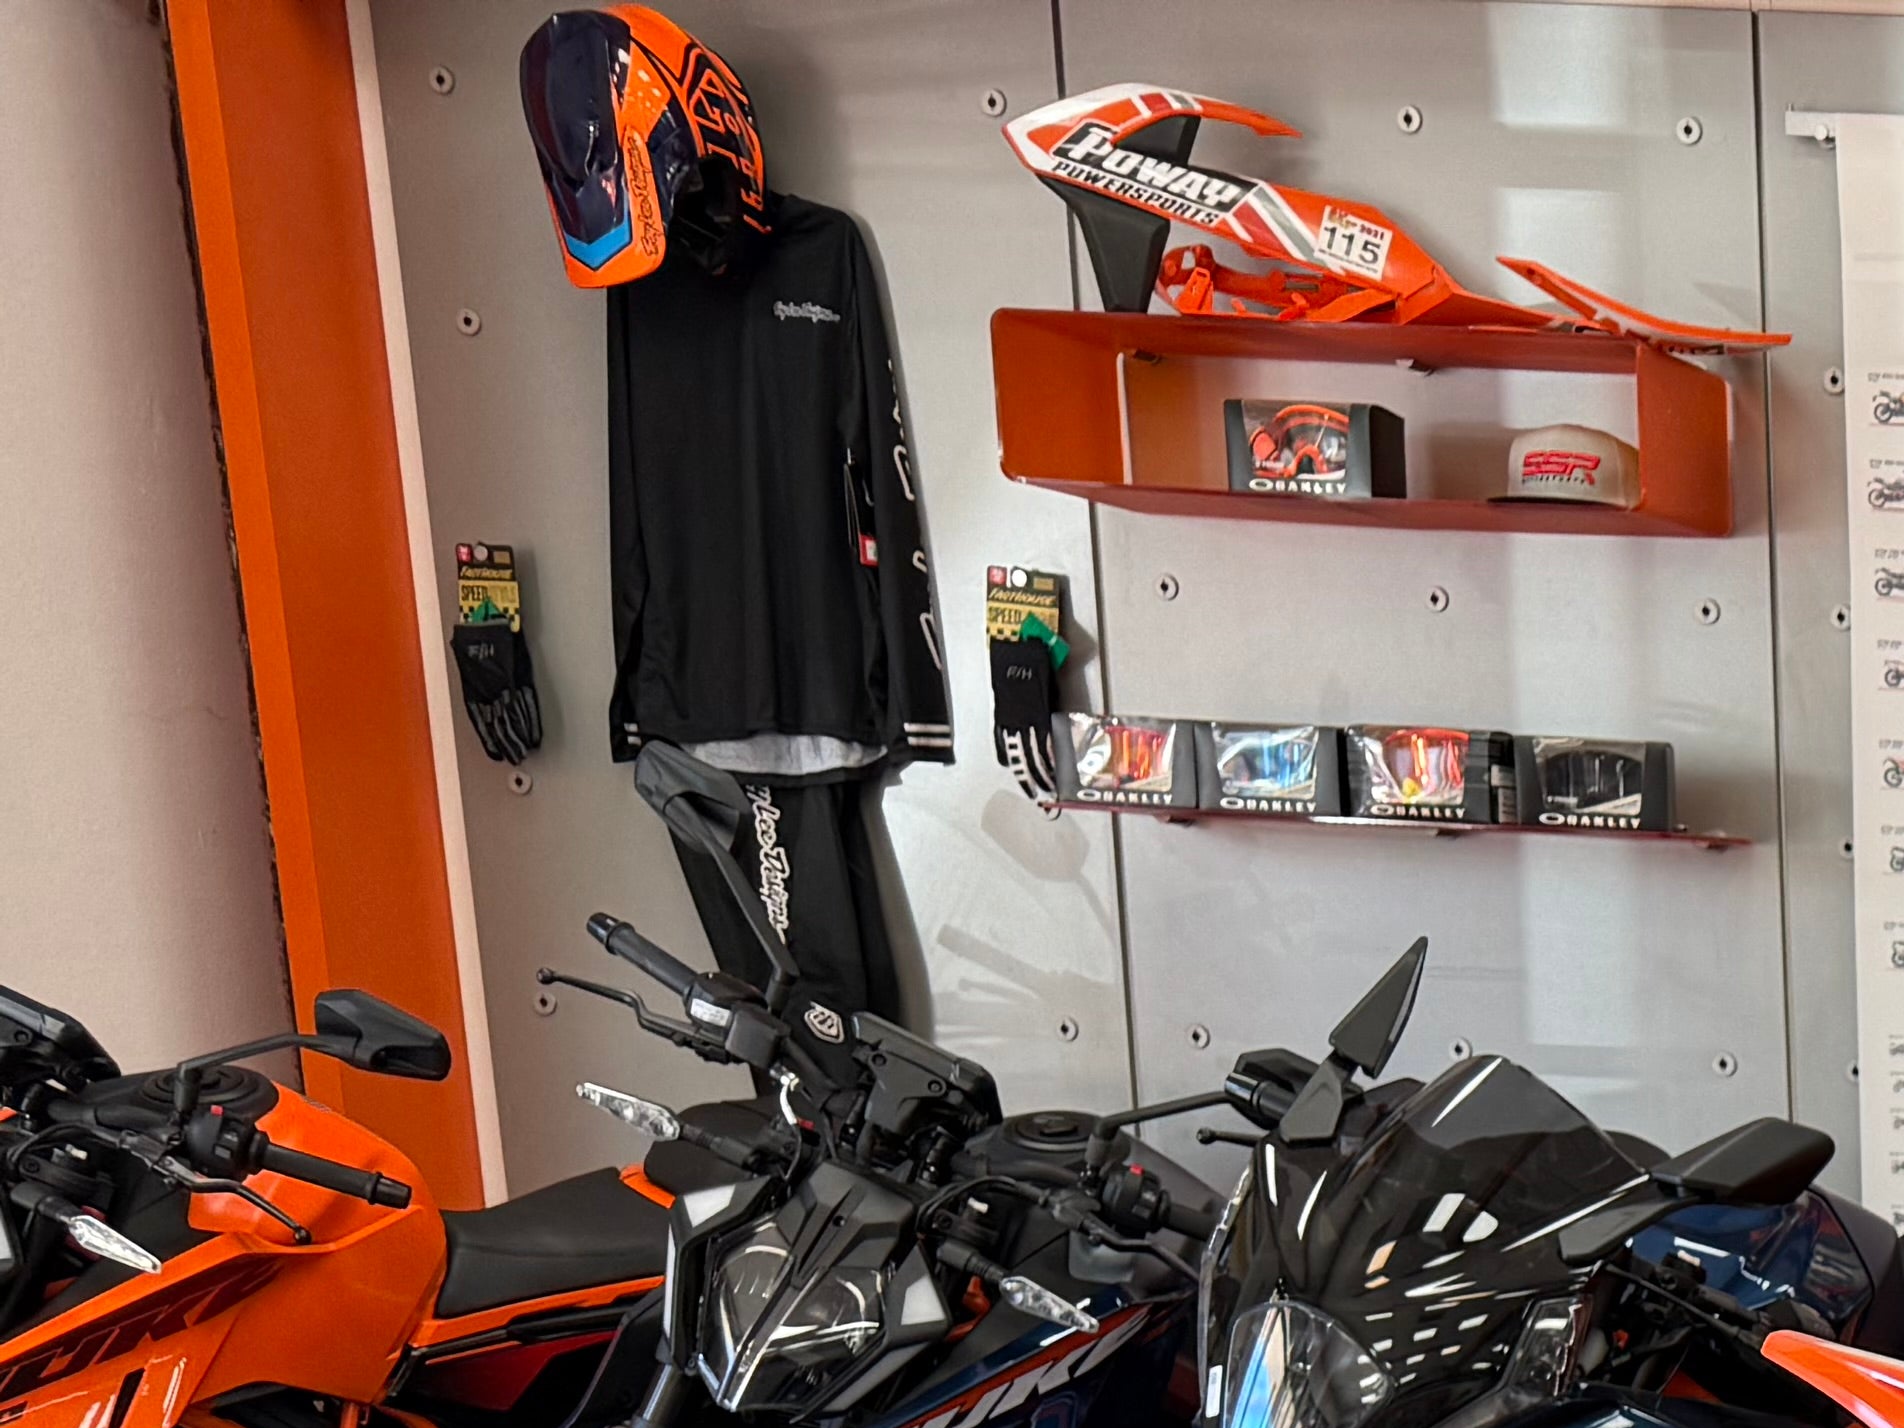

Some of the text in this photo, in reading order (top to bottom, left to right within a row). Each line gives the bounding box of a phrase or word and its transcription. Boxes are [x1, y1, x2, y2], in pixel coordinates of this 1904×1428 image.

[1068, 127, 1241, 206] POWAY
[1051, 159, 1220, 226] POWERSPORTS
[1323, 226, 1382, 265] 115
[1274, 479, 1347, 495] OAKLEY
[1103, 790, 1173, 805] OAKLEY
[1246, 799, 1317, 813] OAKLEY
[1395, 805, 1466, 820] OAKLEY
[1566, 814, 1642, 830] OAKLEY
